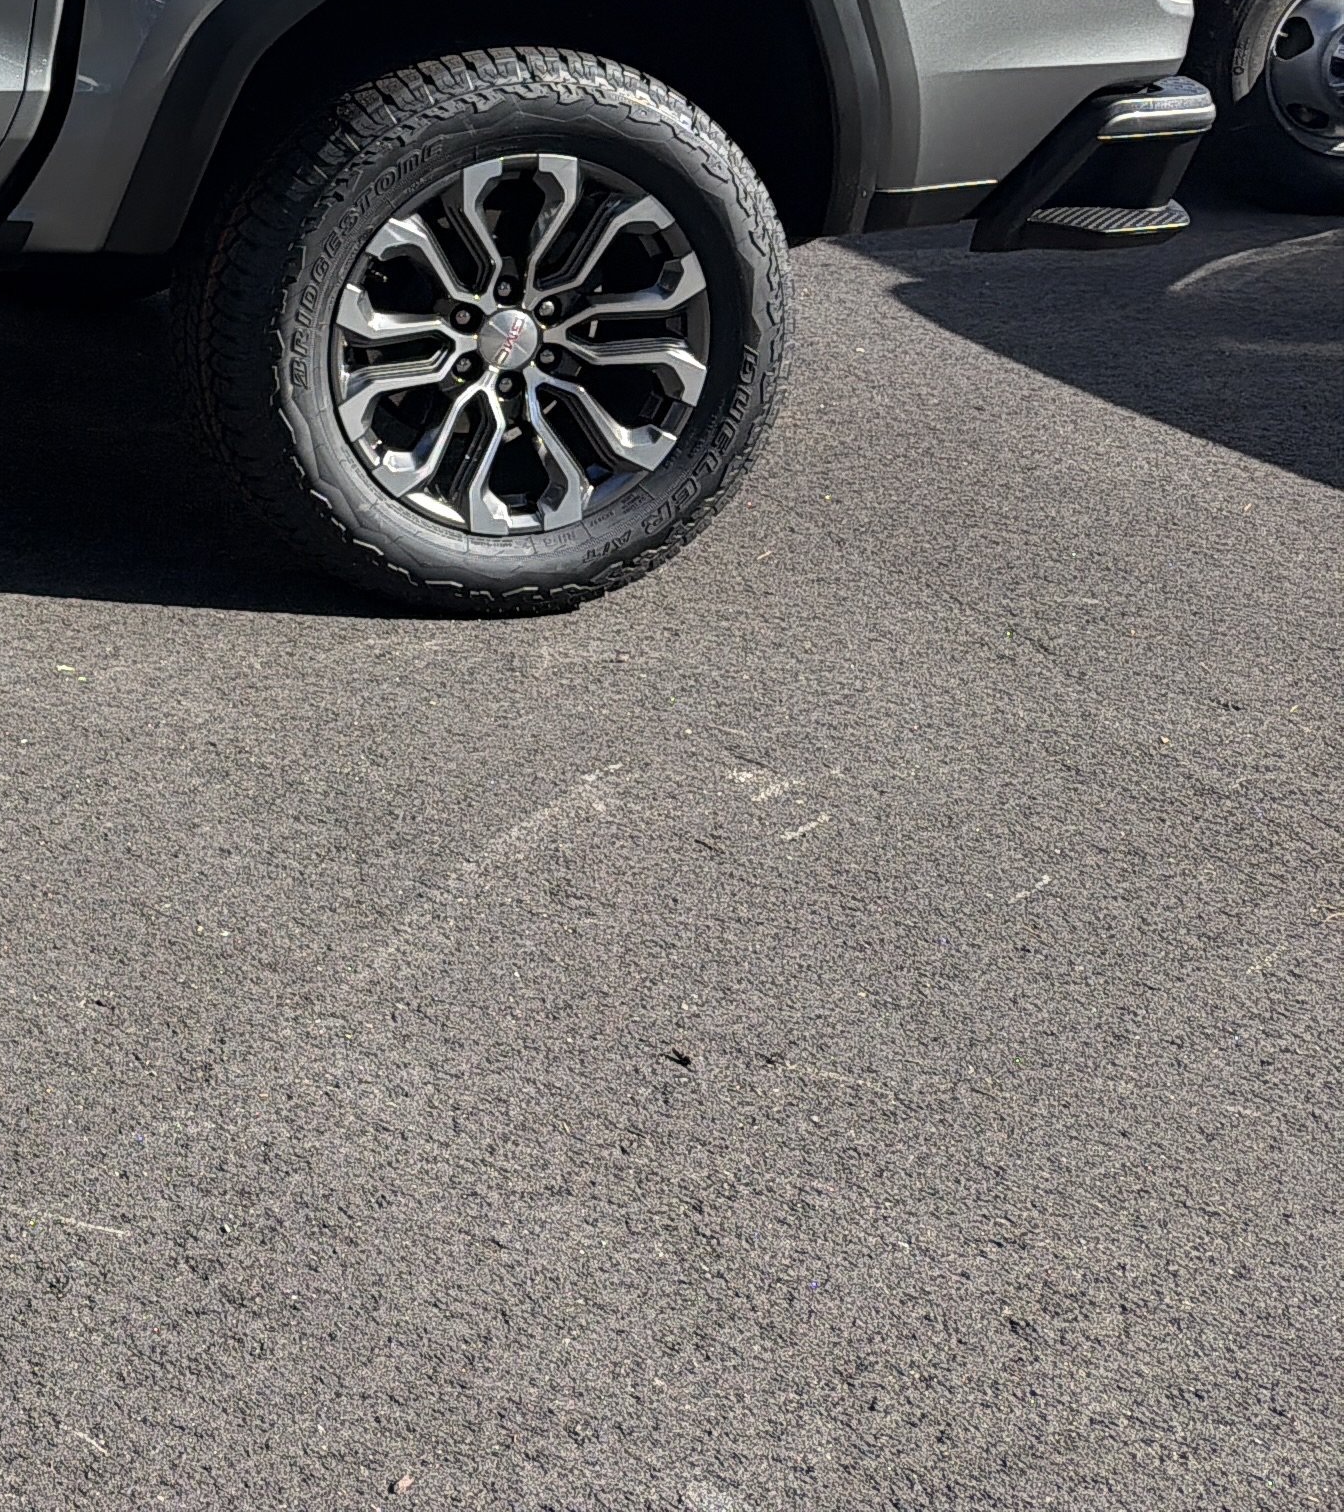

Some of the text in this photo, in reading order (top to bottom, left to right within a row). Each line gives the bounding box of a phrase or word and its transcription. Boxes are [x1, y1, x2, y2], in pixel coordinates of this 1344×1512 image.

[290, 134, 445, 390] BRIDGESTONE
[494, 316, 526, 367] GMC
[641, 344, 760, 535] DUELER
